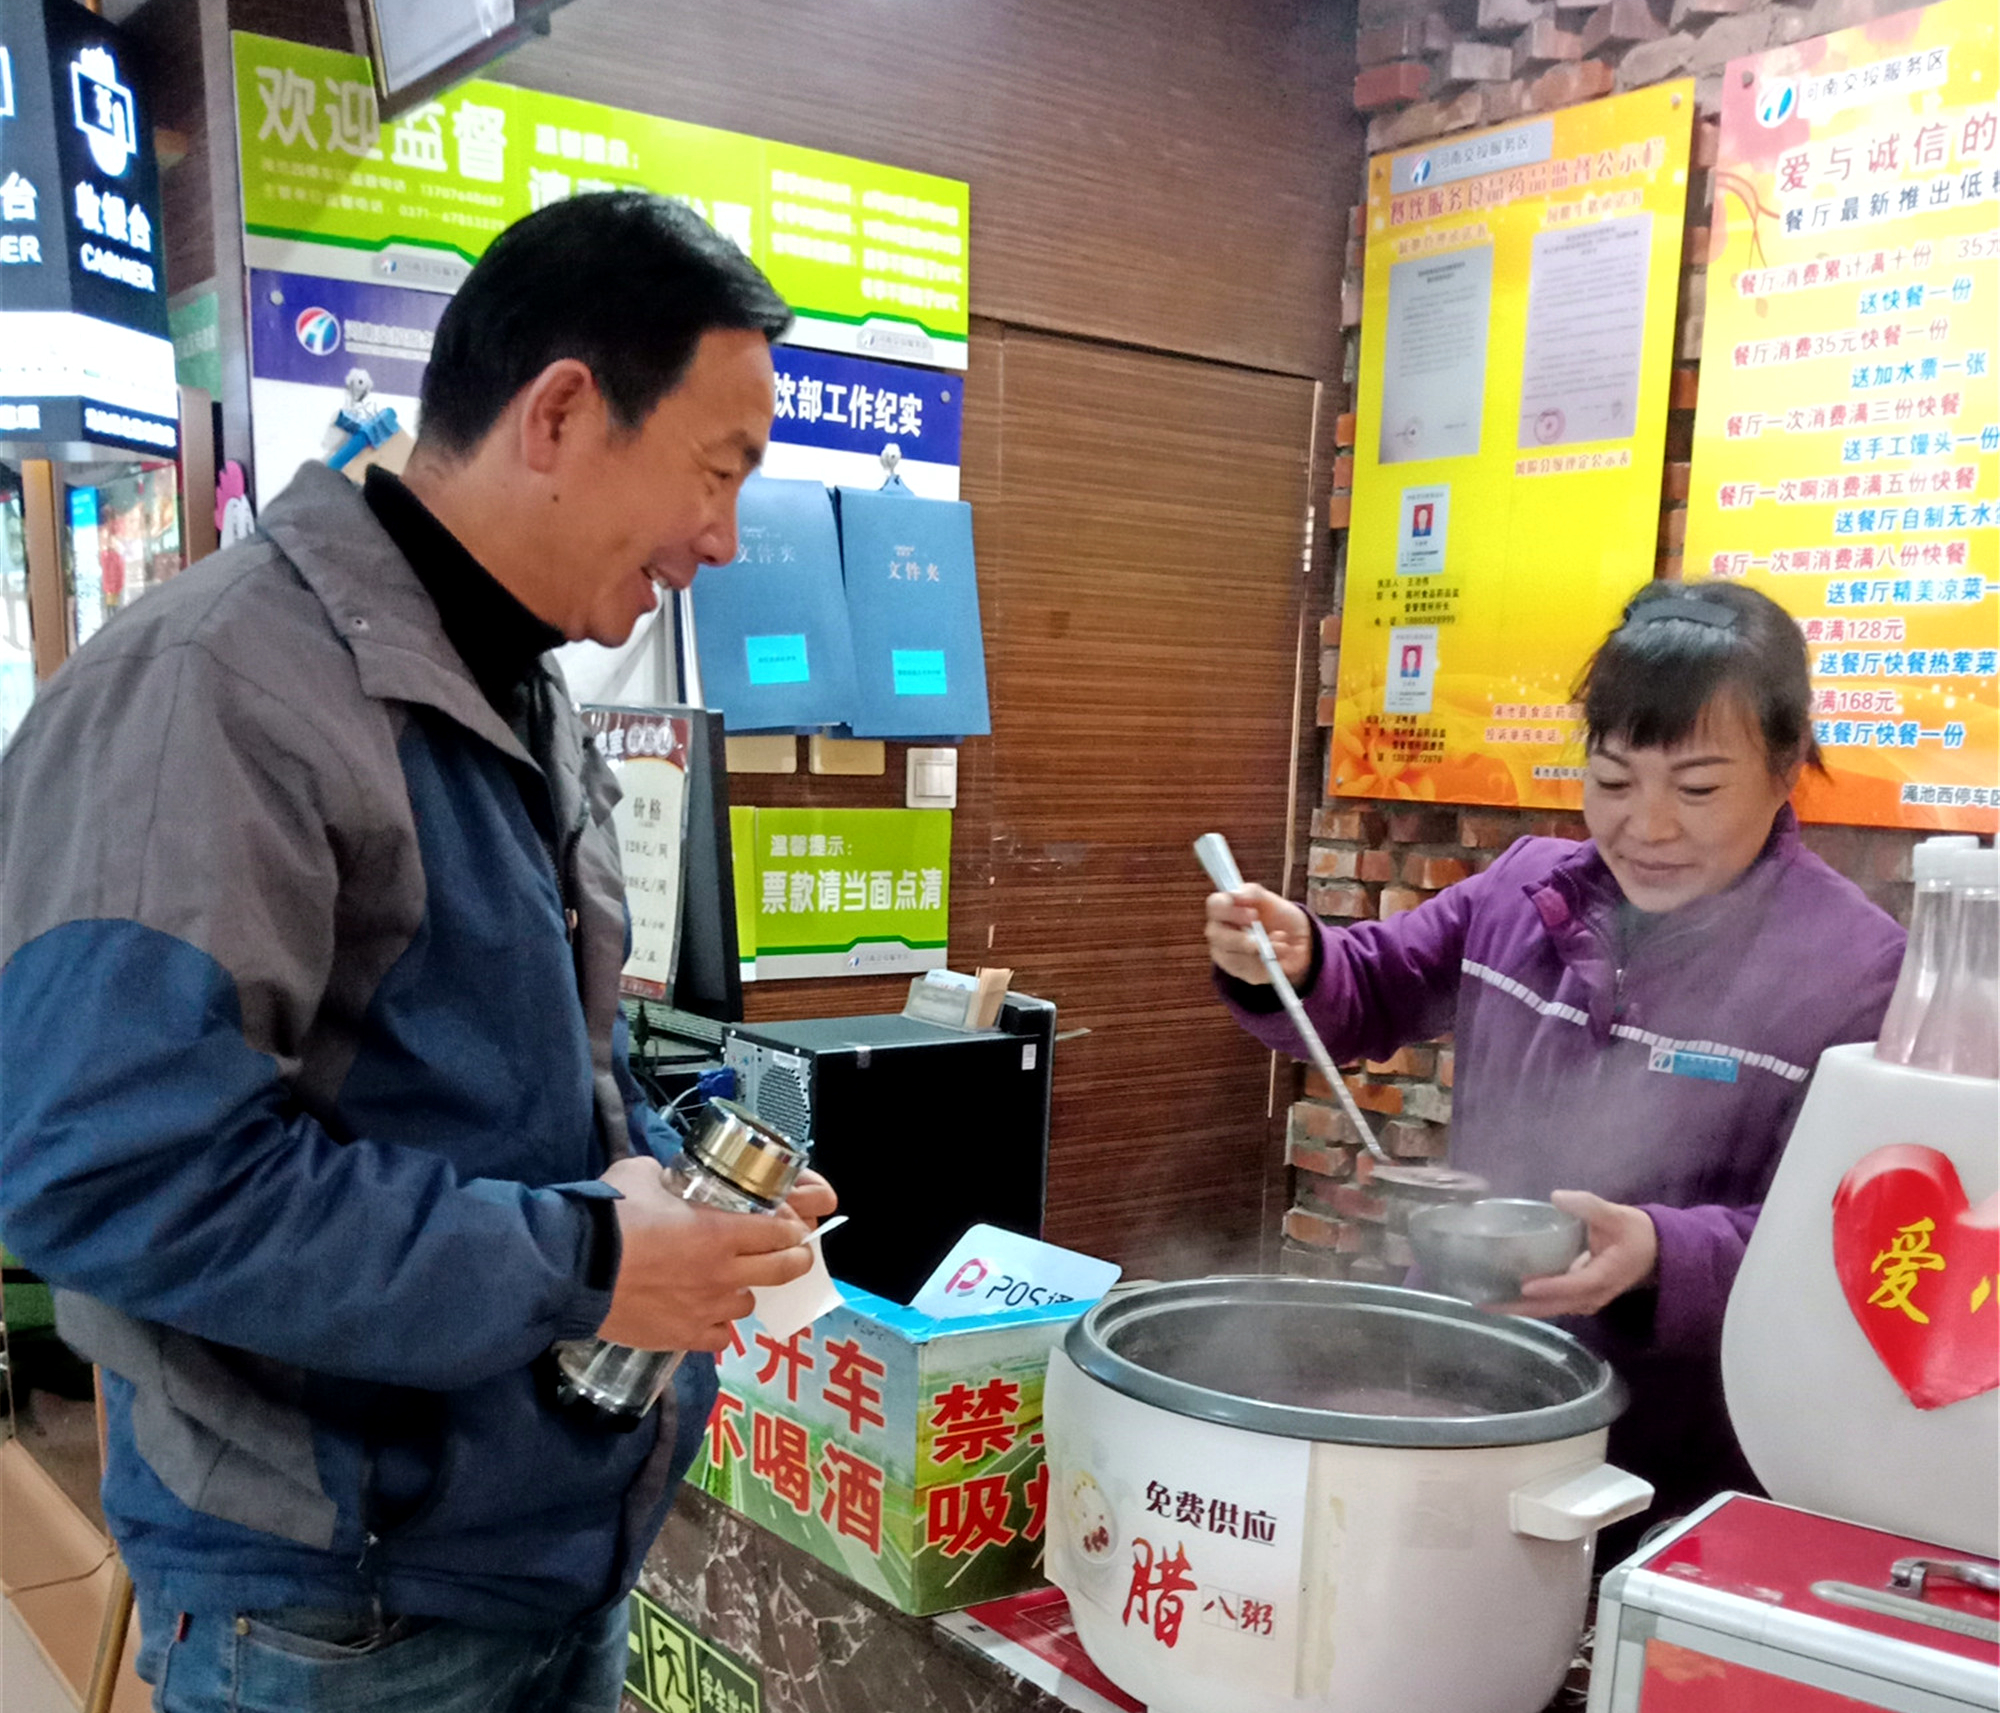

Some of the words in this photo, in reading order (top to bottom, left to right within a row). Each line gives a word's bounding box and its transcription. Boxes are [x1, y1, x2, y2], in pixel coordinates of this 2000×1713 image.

[256, 66, 507, 183] 欢迎监督
[1780, 111, 1997, 192] 爱与诚信的
[75, 180, 152, 252] 收银台
[1741, 244, 1932, 297] 餐厅消费累计满十份
[1859, 276, 1972, 315] 送快餐一份
[1734, 318, 1948, 367] 餐厅消费35元快餐一份
[1851, 352, 1986, 388] 送加水票一张
[773, 371, 923, 438] 饮部工作纪实
[1726, 392, 1960, 438] 餐厅一次消费满三份快餐
[1842, 425, 2000, 462] 送手工馒头一份
[1719, 466, 1975, 507] 餐厅一次啊消费满五份快餐
[888, 560, 940, 582] 文件夹
[1711, 542, 1967, 576] 餐厅一次啊消费满八份快餐
[1797, 619, 1904, 642] 费满128元
[1819, 650, 1998, 675] 送餐厅快餐热荤菜
[1811, 690, 1895, 713] 满168元
[1815, 721, 1965, 747] 送餐厅快餐一份
[770, 834, 852, 857] 温馨提示：
[761, 867, 943, 914] 票款请当面点清
[706, 1388, 884, 1556] 不喝酒
[1145, 1480, 1279, 1547] 免费供应
